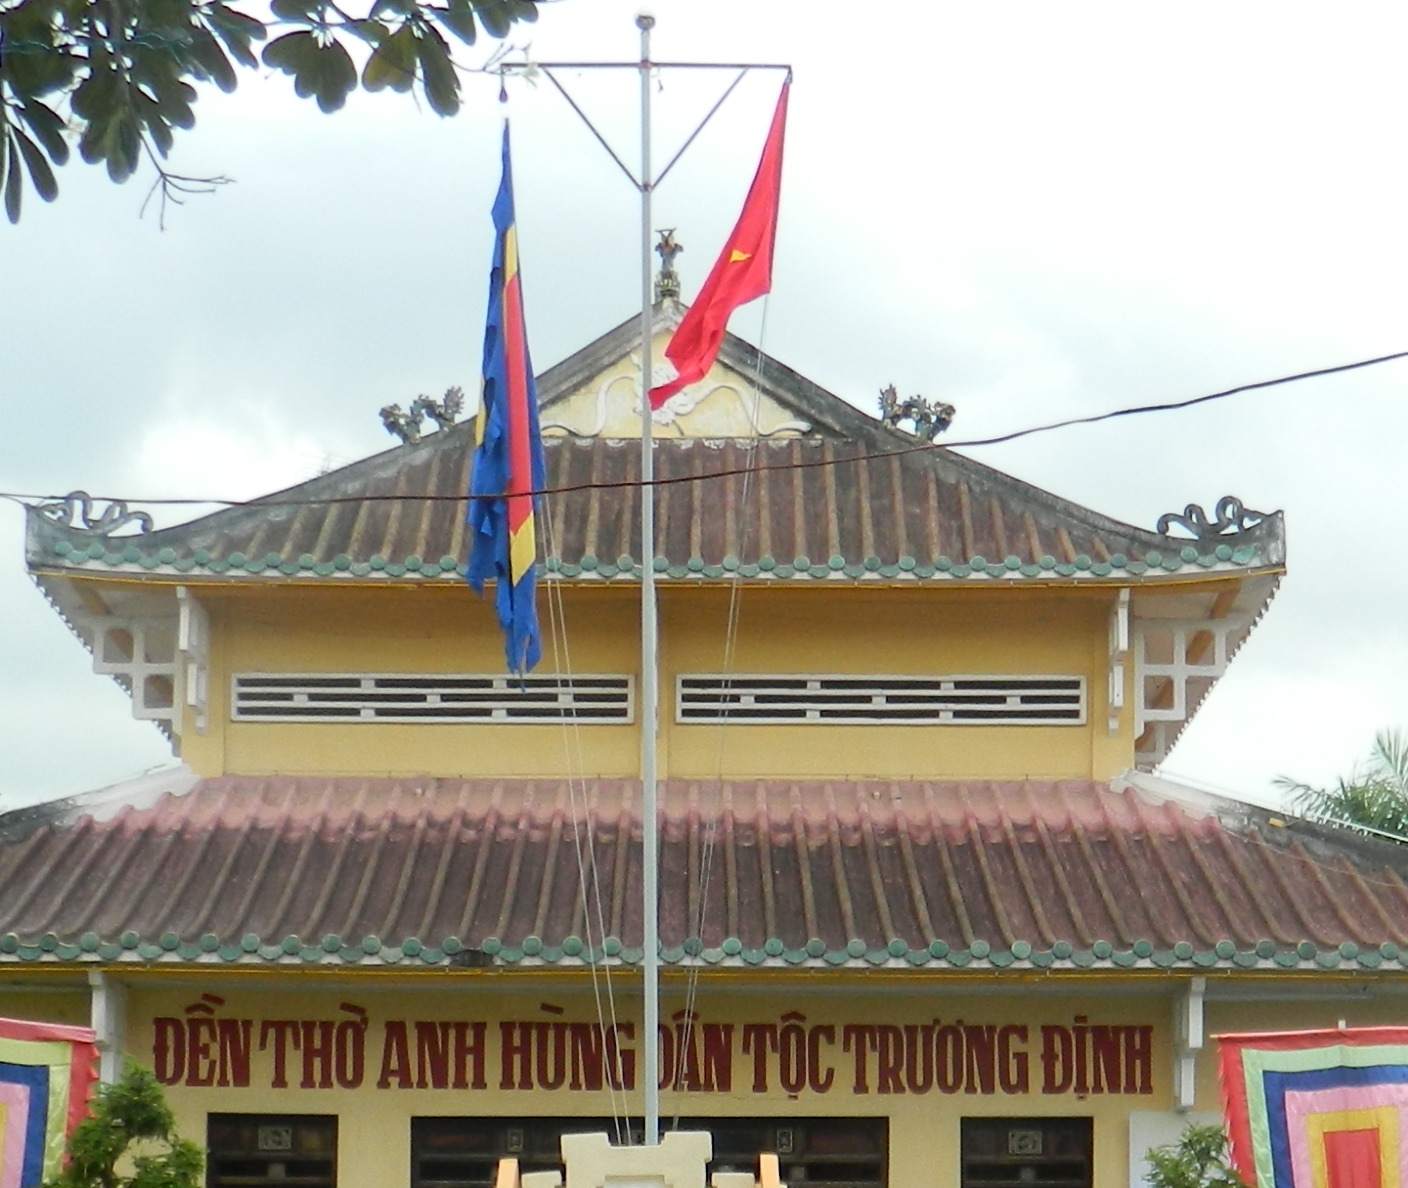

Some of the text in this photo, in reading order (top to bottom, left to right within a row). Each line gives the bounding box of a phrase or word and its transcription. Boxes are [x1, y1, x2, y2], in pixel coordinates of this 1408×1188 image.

[153, 992, 253, 1087] ĐỀN
[259, 1002, 369, 1090] THỜ
[377, 1020, 488, 1090] ANH
[499, 1002, 636, 1092] HÙNG
[743, 1010, 837, 1100] TỘC
[843, 1017, 1030, 1095] TRƯƠNG
[1040, 1014, 1155, 1100] ĐỊNH
